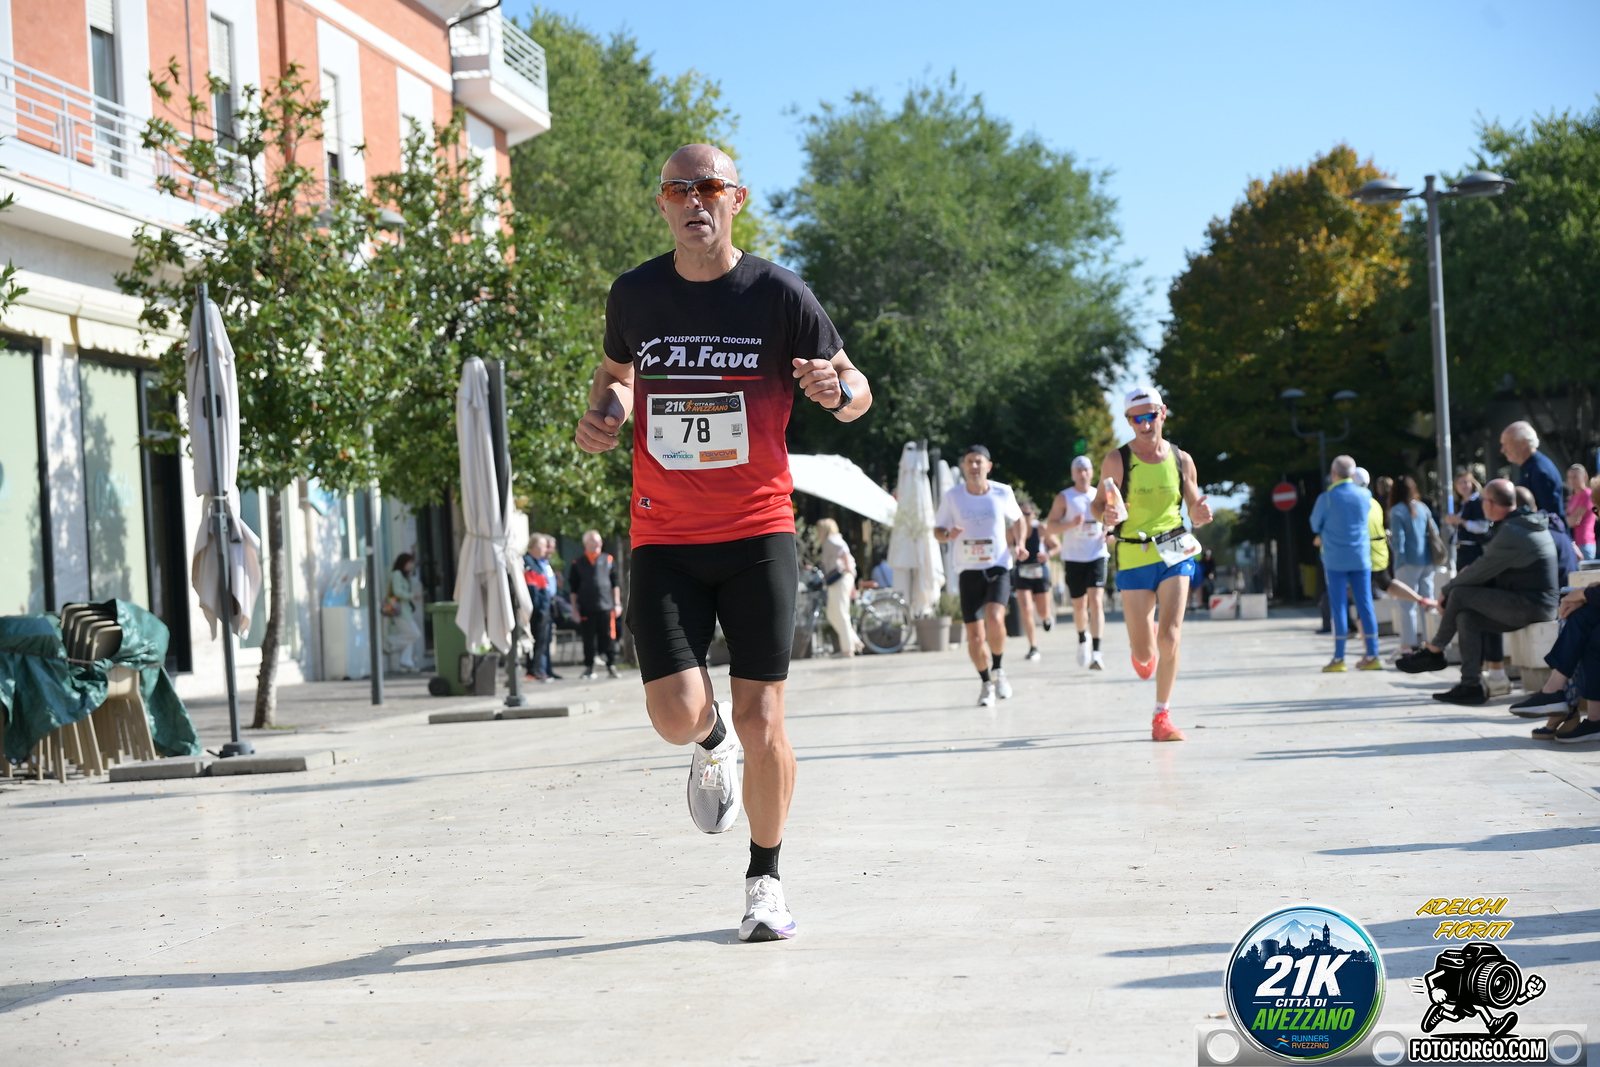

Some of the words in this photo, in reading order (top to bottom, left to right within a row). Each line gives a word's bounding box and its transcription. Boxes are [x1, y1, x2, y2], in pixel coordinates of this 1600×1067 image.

[722, 336, 762, 345] CIOCIARA
[664, 345, 759, 368] A.Fava
[665, 400, 686, 413] 21K
[681, 417, 711, 443] 78
